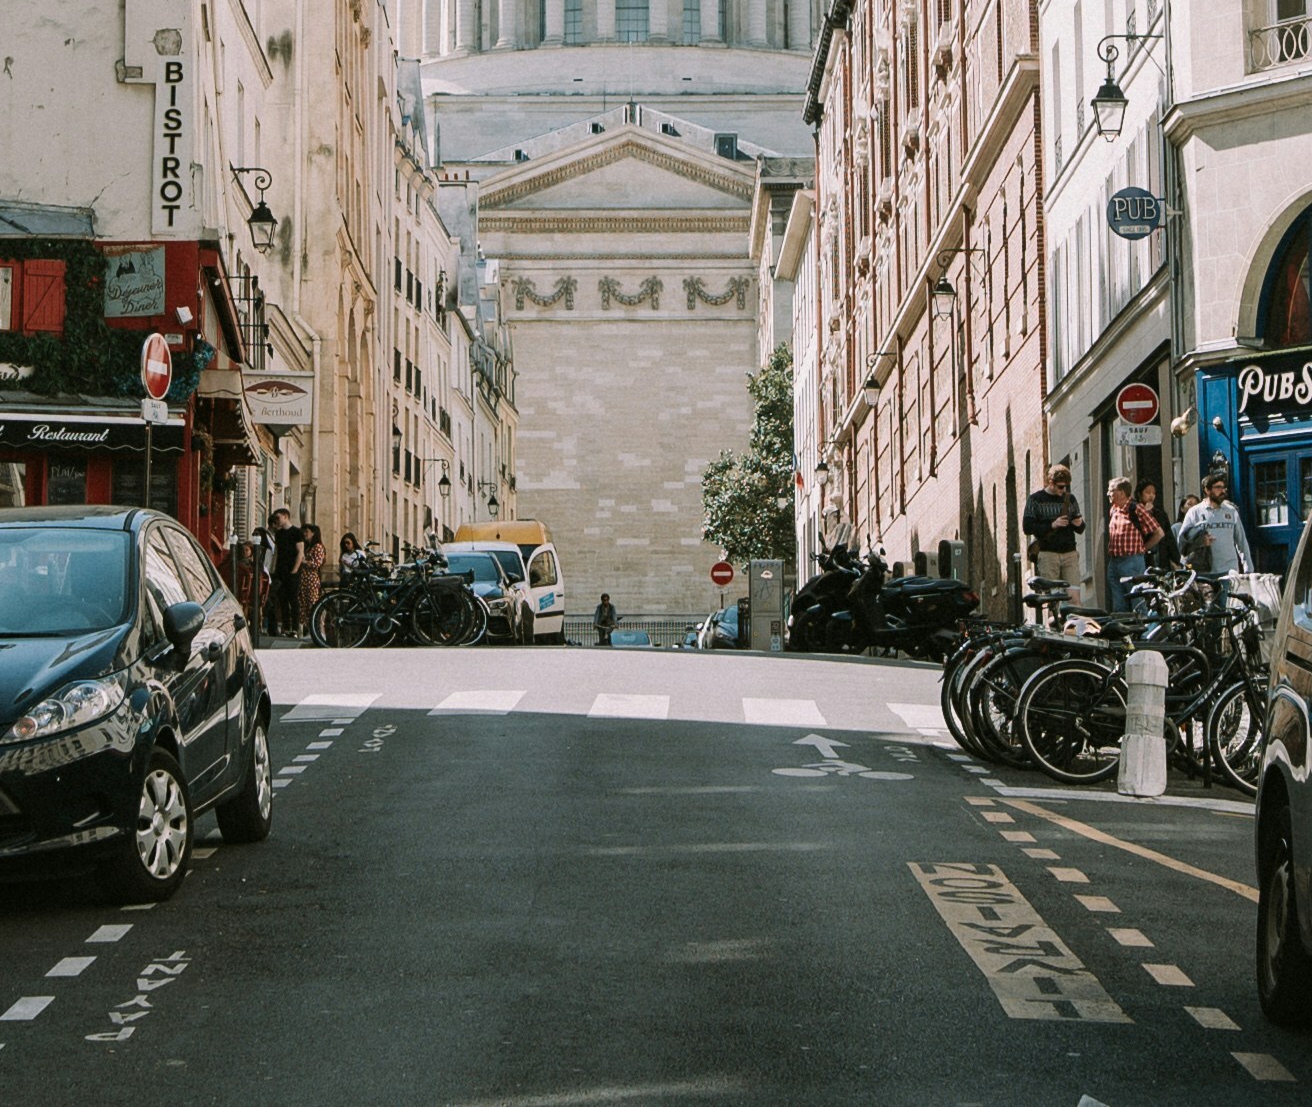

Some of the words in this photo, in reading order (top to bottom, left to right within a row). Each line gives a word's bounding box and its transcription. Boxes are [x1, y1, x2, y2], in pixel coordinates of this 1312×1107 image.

[160, 61, 184, 227] BISTROT
[1113, 197, 1157, 221] PUB
[1238, 364, 1295, 414] PUB
[27, 424, 110, 442] Restaurant
[84, 950, 193, 1042] PAYANT
